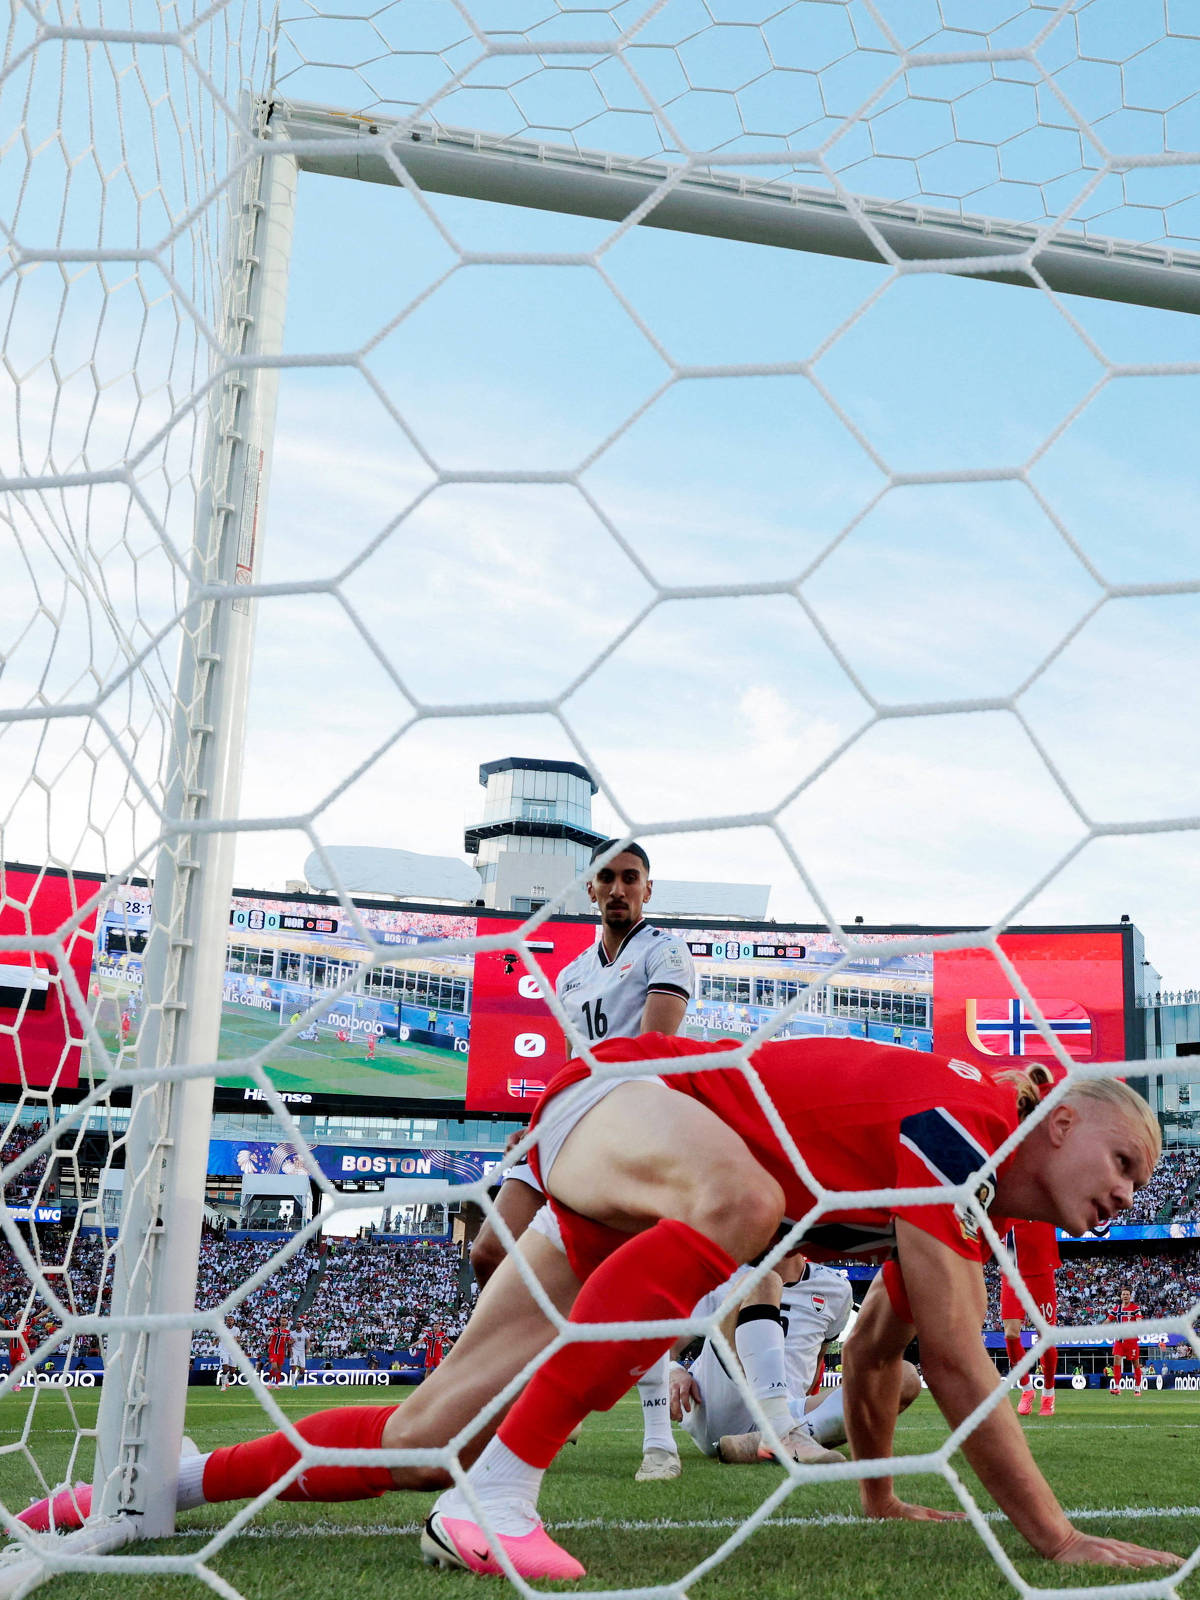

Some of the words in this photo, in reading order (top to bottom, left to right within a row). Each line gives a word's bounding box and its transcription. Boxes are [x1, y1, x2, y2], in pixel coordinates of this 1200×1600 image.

[237, 914, 245, 925] 0
[268, 916, 276, 927] 0
[283, 916, 305, 929] NOR
[384, 933, 419, 945] BOSTON
[691, 943, 707, 955] IRQ
[715, 945, 723, 956] 0
[742, 946, 750, 957] 0
[757, 946, 776, 957] NOR
[581, 998, 609, 1041] 16
[685, 1013, 715, 1030] ootball
[454, 1037, 470, 1053] fo
[341, 1155, 431, 1175] BOSTON
[1040, 1302, 1053, 1319] 10
[304, 1370, 317, 1385] is
[322, 1370, 390, 1386] calling
[1109, 1375, 1149, 1391] motola
[643, 1397, 667, 1408] JAKO
